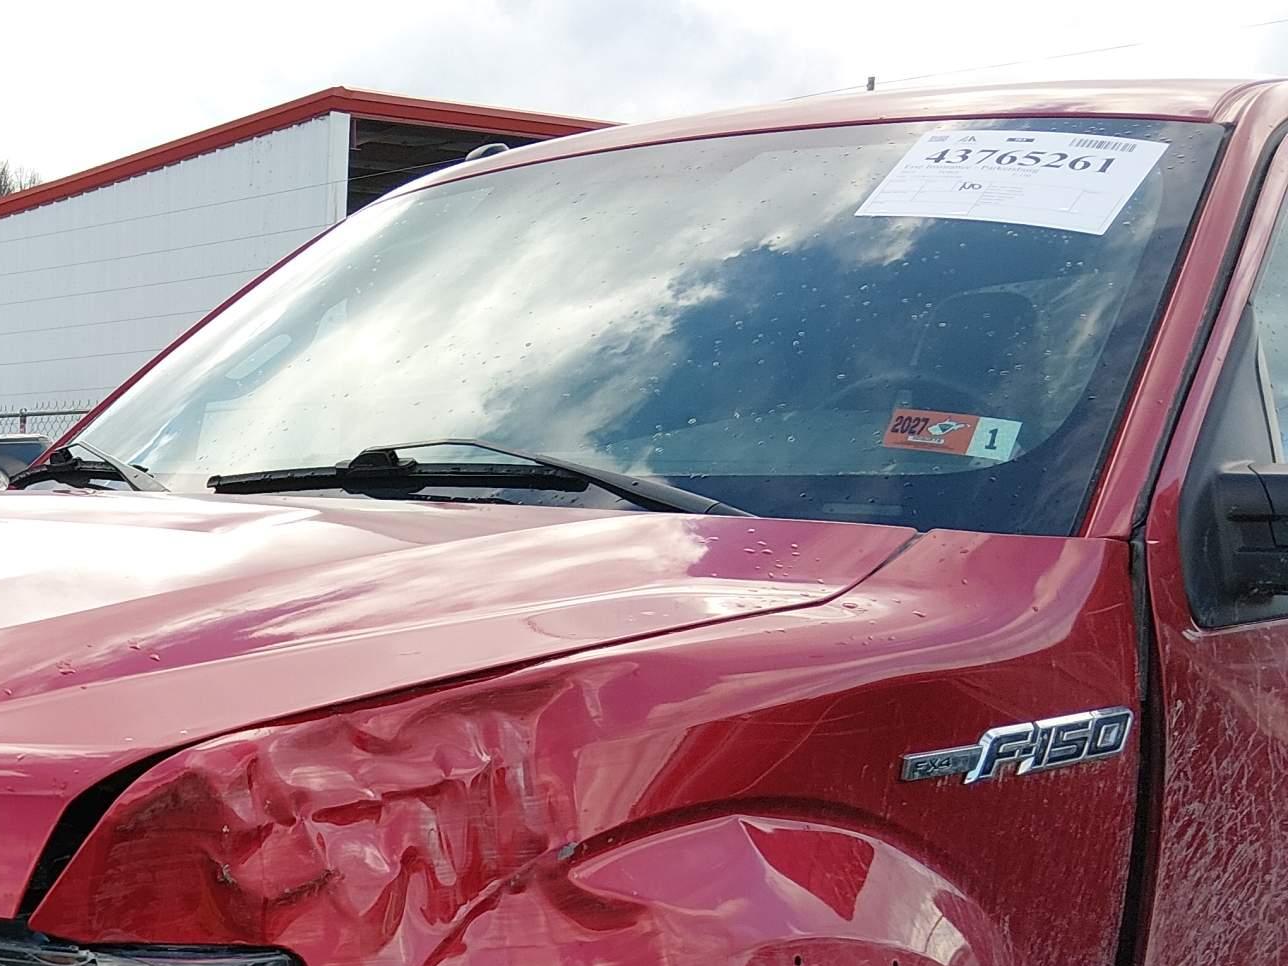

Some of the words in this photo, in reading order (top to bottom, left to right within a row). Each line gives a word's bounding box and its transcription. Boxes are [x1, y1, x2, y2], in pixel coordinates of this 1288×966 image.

[925, 148, 1117, 175] 43765261
[890, 415, 930, 436] 2027
[984, 428, 999, 450] 1
[914, 756, 952, 774] FX4
[963, 705, 1134, 785] F-150
